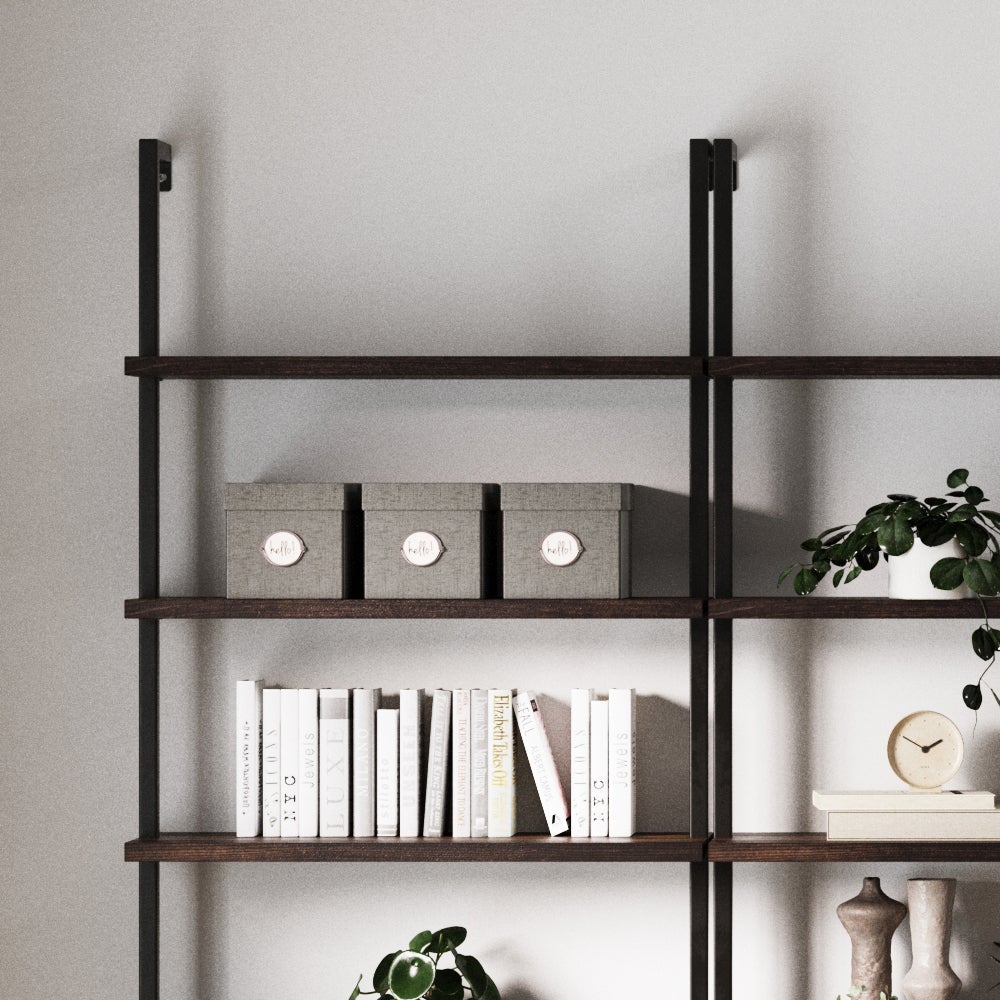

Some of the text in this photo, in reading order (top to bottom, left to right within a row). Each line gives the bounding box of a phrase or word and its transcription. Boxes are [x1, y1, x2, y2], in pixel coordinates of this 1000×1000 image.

[270, 540, 295, 557] hello!
[408, 540, 433, 557] hello!
[547, 540, 572, 557] hello!
[493, 694, 510, 740] Elizabeth
[302, 732, 315, 788] Jewels
[492, 741, 509, 769] Takes
[614, 731, 628, 788] Jewels
[326, 729, 344, 829] LUXE
[492, 770, 508, 787] Off
